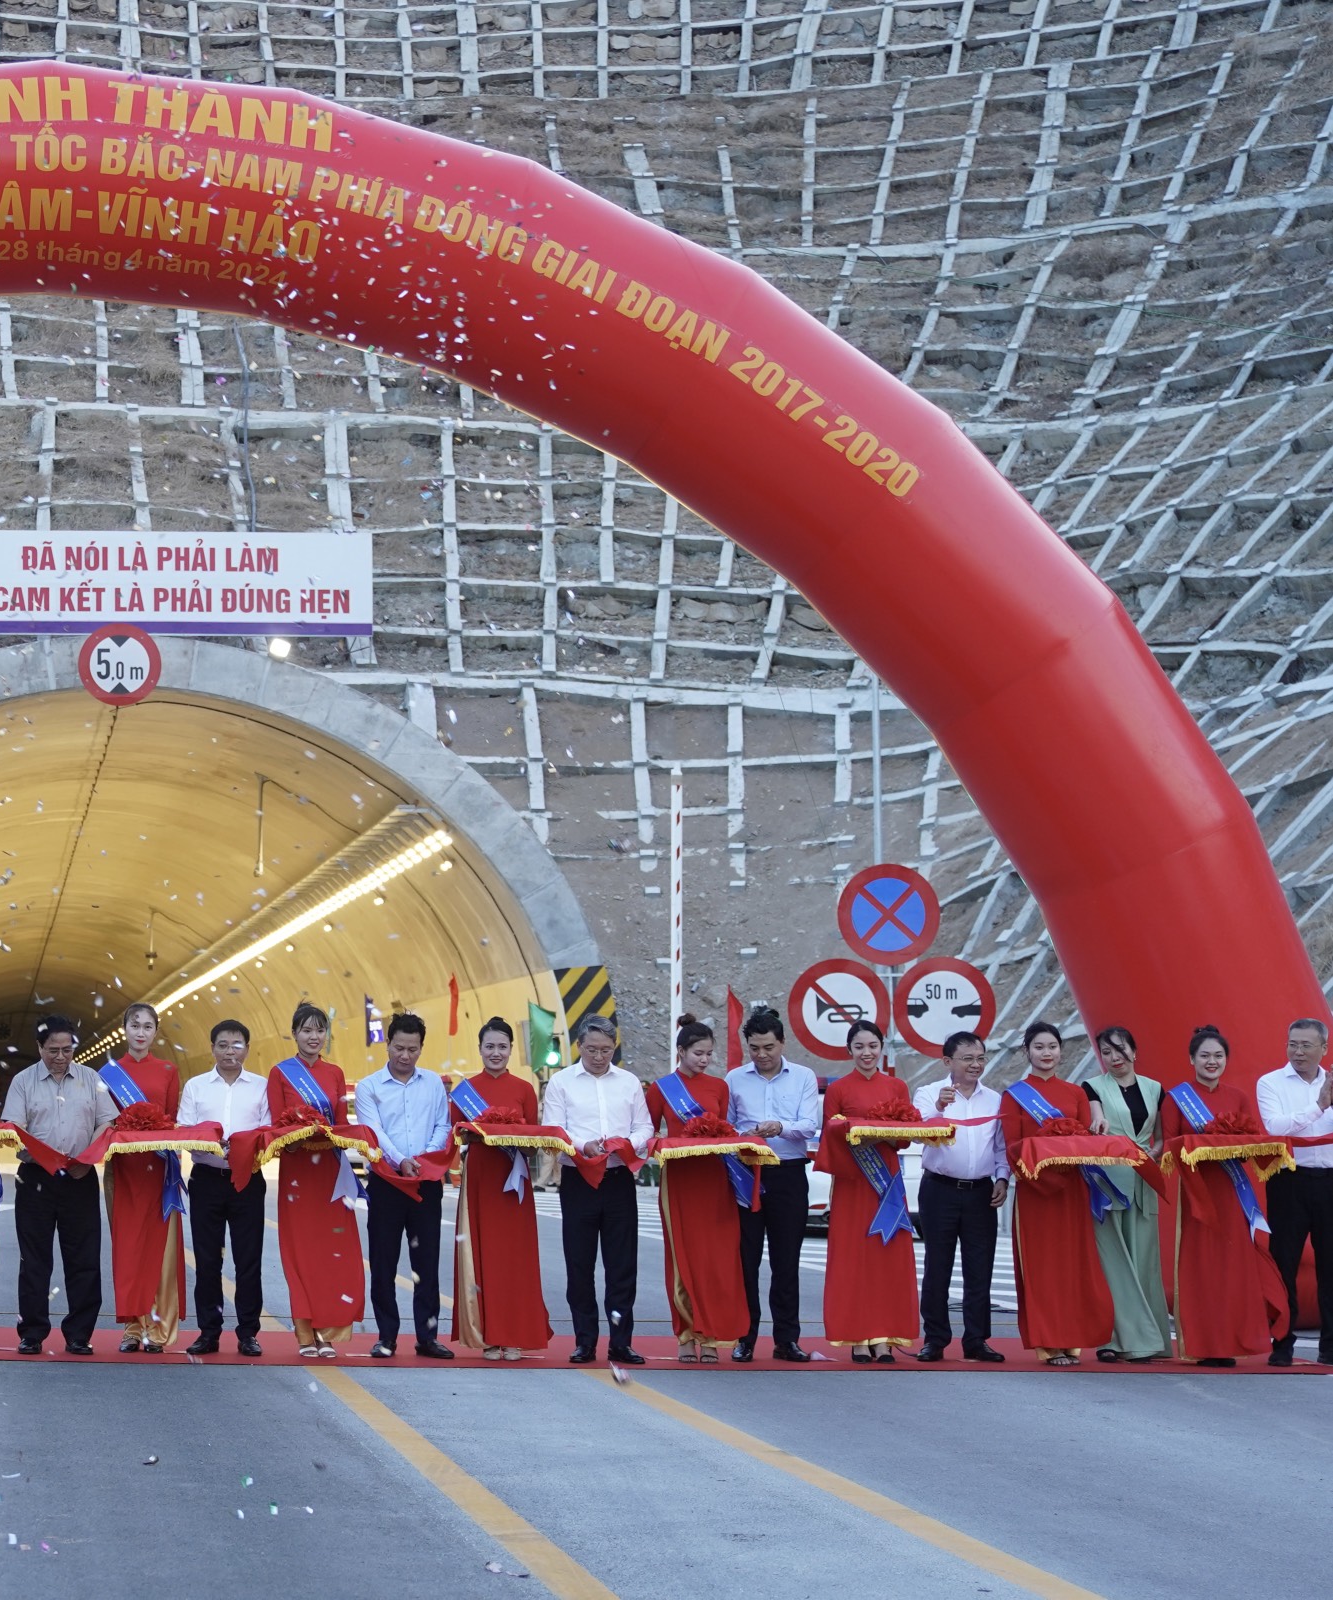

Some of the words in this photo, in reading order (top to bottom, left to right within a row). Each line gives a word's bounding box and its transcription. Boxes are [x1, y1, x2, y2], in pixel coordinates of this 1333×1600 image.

[108, 81, 333, 152] THÀNH
[222, 200, 321, 264] HẢO
[37, 240, 122, 271] tháng
[216, 258, 288, 286] 2024
[10, 122, 87, 172] TỐC
[99, 132, 303, 197] BẮC-NAM
[308, 166, 405, 225] PHÍA
[413, 195, 528, 265] ĐÔNG
[531, 239, 618, 304] GIAI
[615, 279, 731, 364] ĐOẠN
[728, 346, 919, 497] 2017-2020
[21, 541, 56, 571] ĐÃ
[65, 541, 108, 571] NÓI
[118, 541, 148, 571] LÀ
[157, 538, 216, 572] PHẢI
[225, 542, 279, 573] LÀM
[59, 579, 106, 612] KẾT
[114, 582, 144, 612] LÀ
[153, 579, 212, 613] PHẢI
[220, 583, 291, 613] ĐÚNG
[300, 588, 350, 619] HẸN
[96, 648, 125, 682] 5,0
[130, 666, 144, 680] m
[925, 983, 941, 1000] 50
[945, 988, 958, 1000] m
